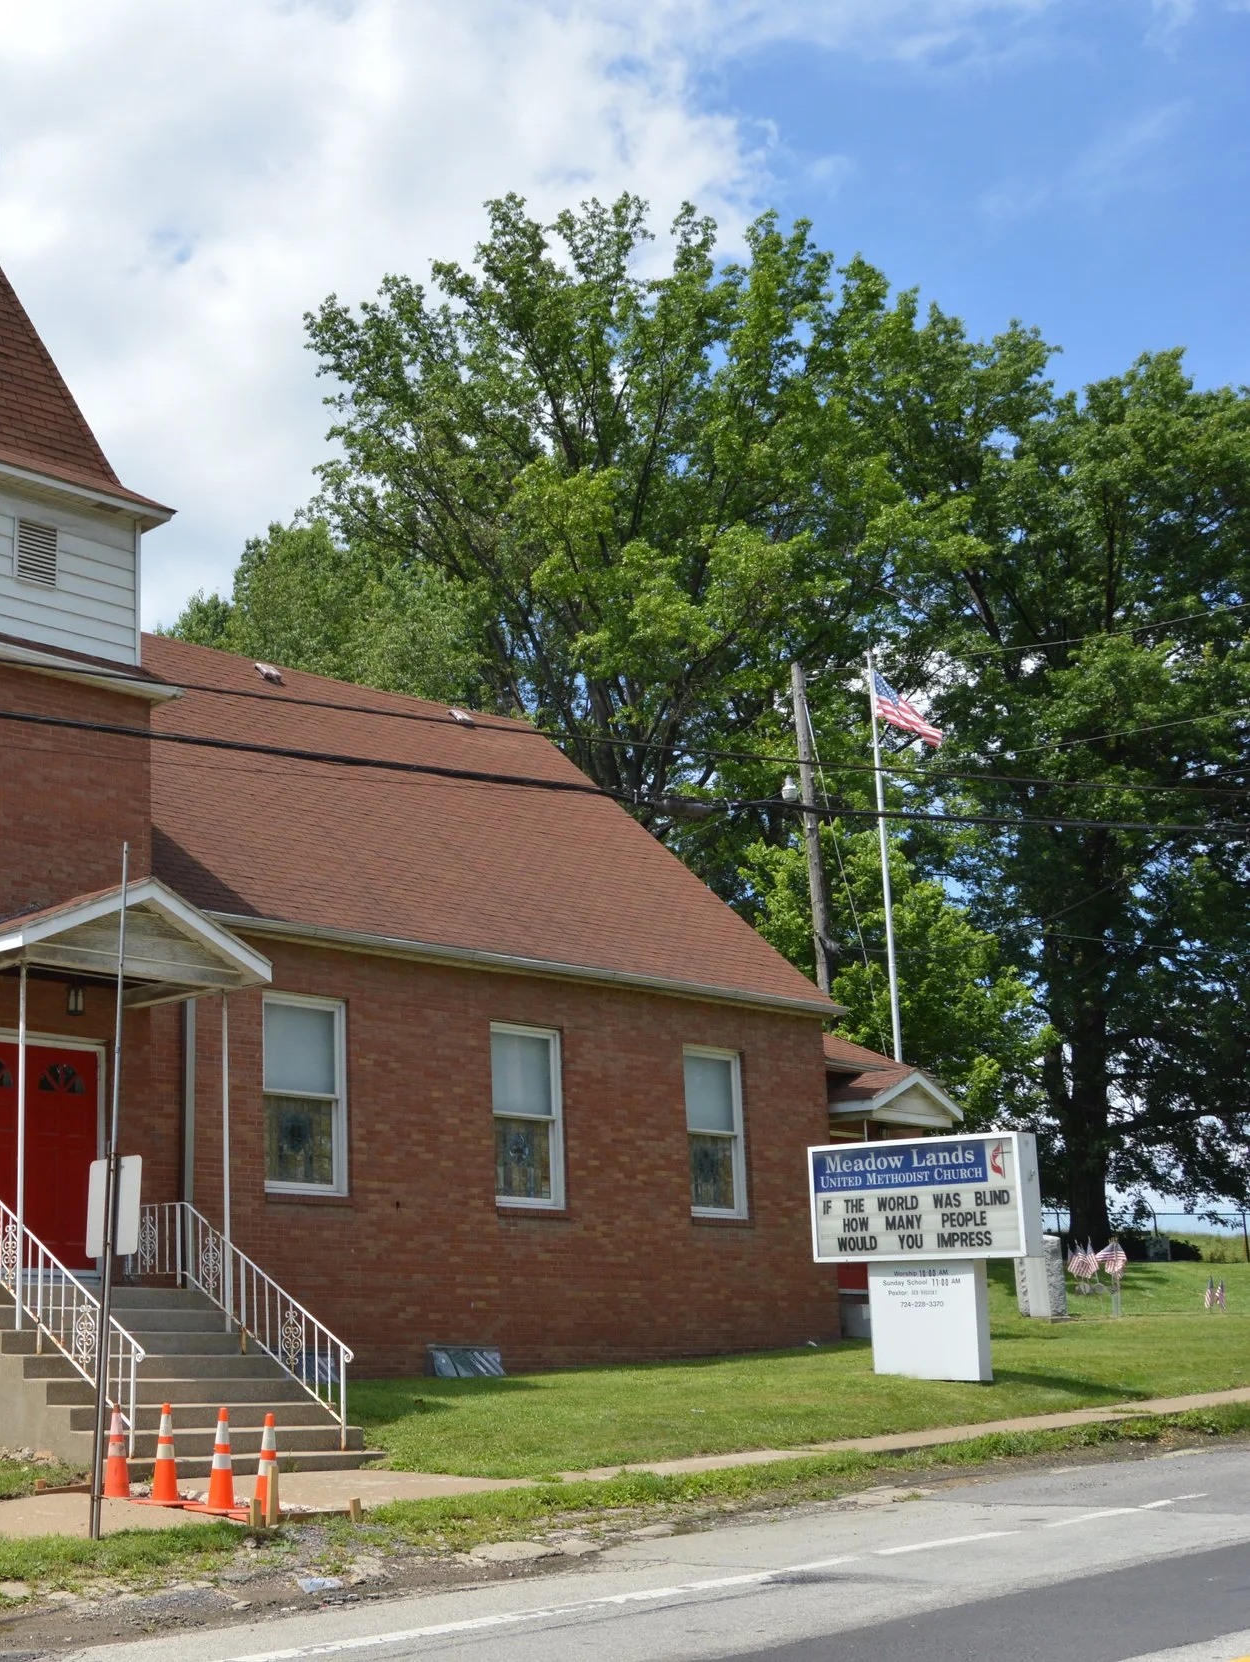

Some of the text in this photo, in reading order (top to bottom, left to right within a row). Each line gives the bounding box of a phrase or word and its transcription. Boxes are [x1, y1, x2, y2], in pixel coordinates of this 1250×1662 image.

[825, 1145, 975, 1174] Meadow Lands
[820, 1167, 983, 1189] UNITED METHODIST CHURCH
[822, 1189, 1010, 1215] IF THE WORLD WAS BLIND
[843, 1210, 987, 1233] HOW MANY PEOPLE
[837, 1230, 993, 1252] WOULD YOU IMPRESS
[882, 1279, 904, 1287] Sunday
[932, 1278, 949, 1287] 11:00
